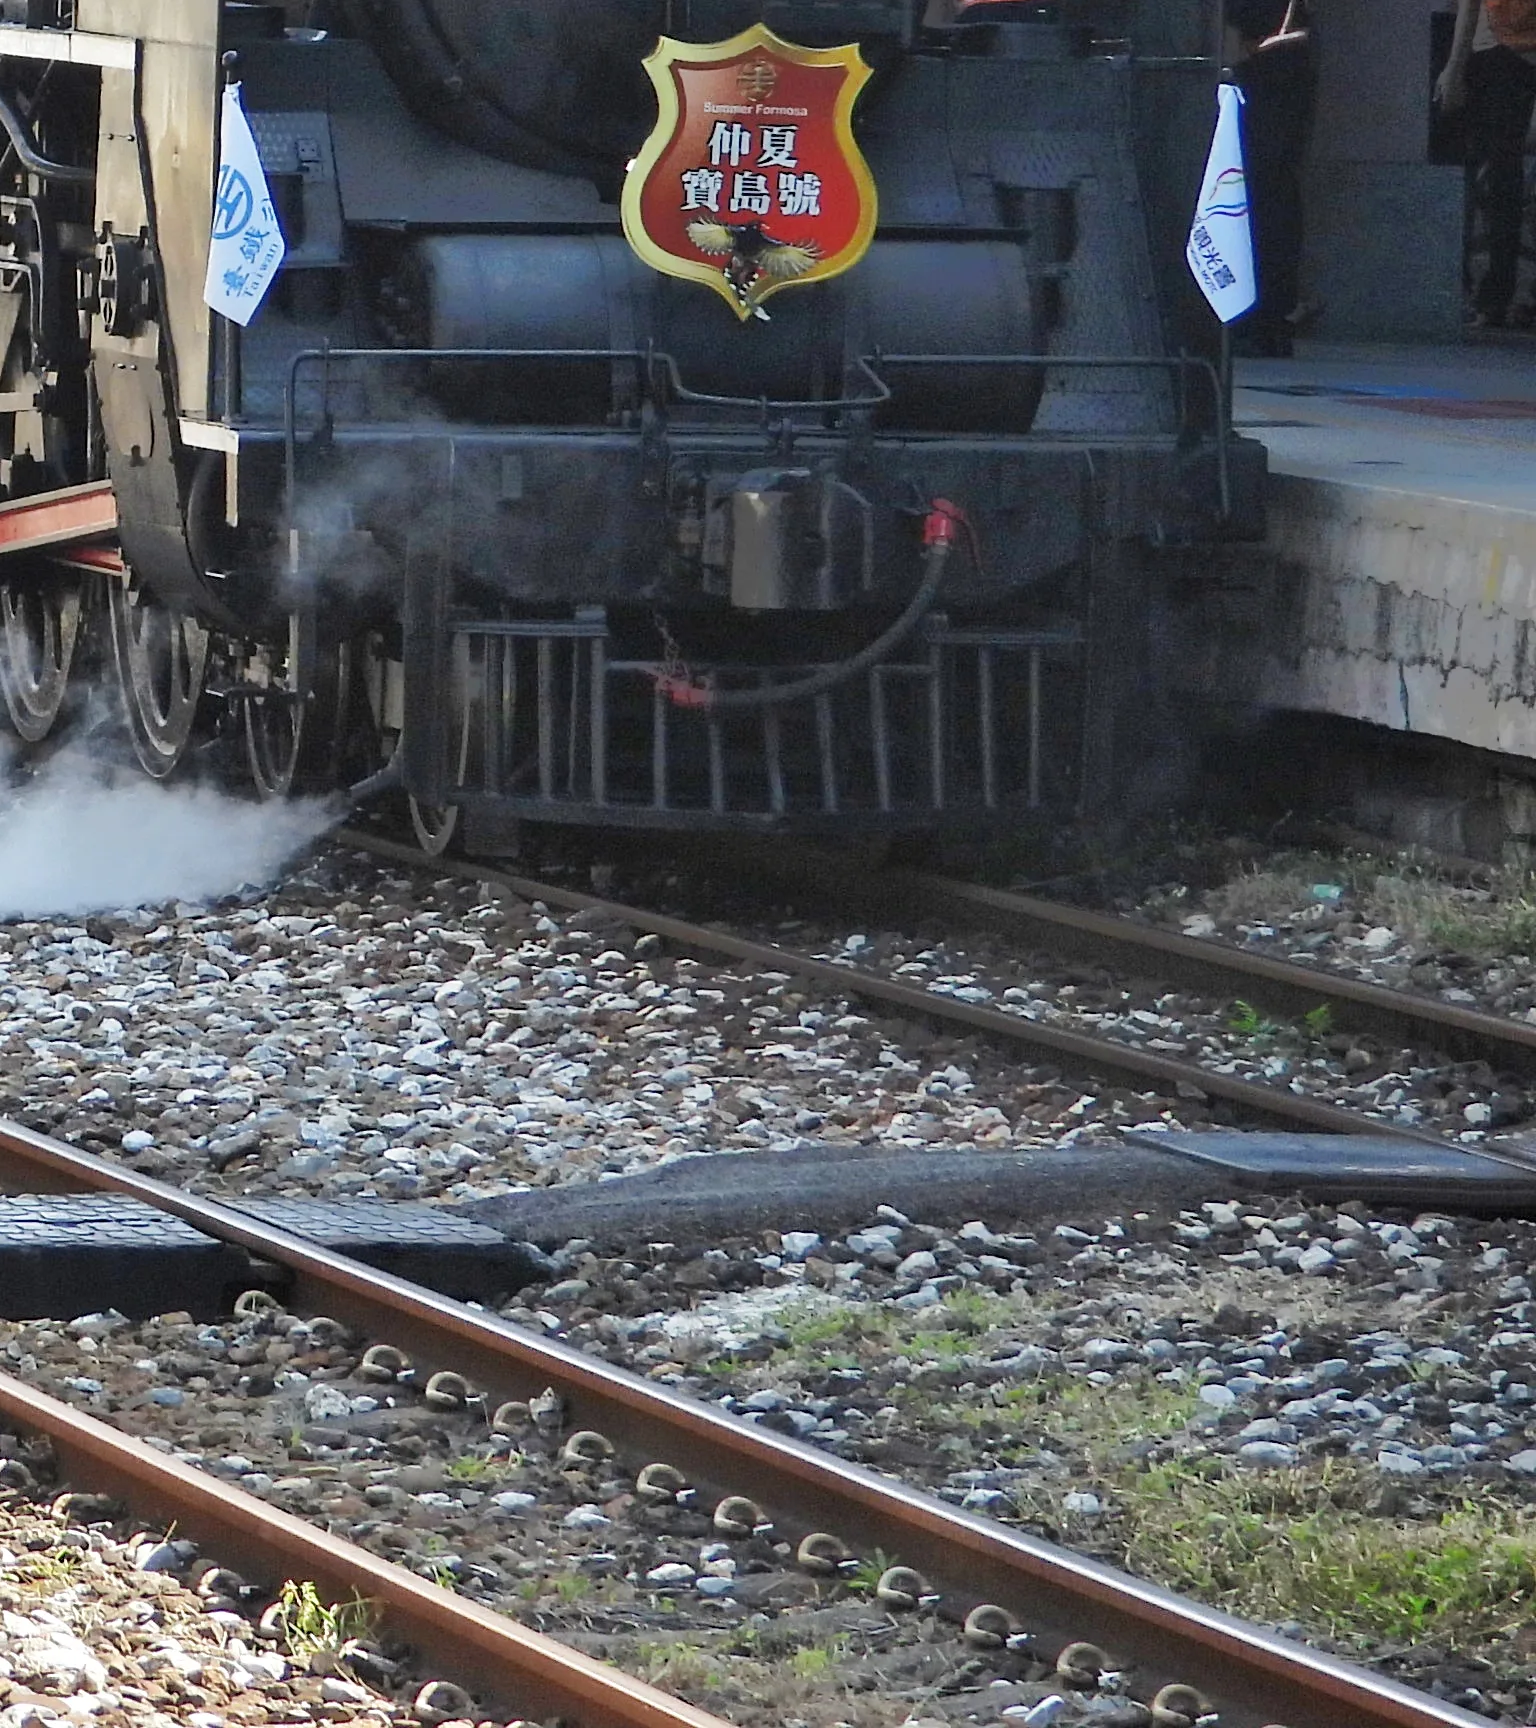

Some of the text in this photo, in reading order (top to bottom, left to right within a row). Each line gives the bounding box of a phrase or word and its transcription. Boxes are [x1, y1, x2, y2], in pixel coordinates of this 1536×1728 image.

[703, 101, 809, 117] Summer Formosa
[708, 121, 799, 169] 仲夏
[680, 168, 821, 217] 寶島號
